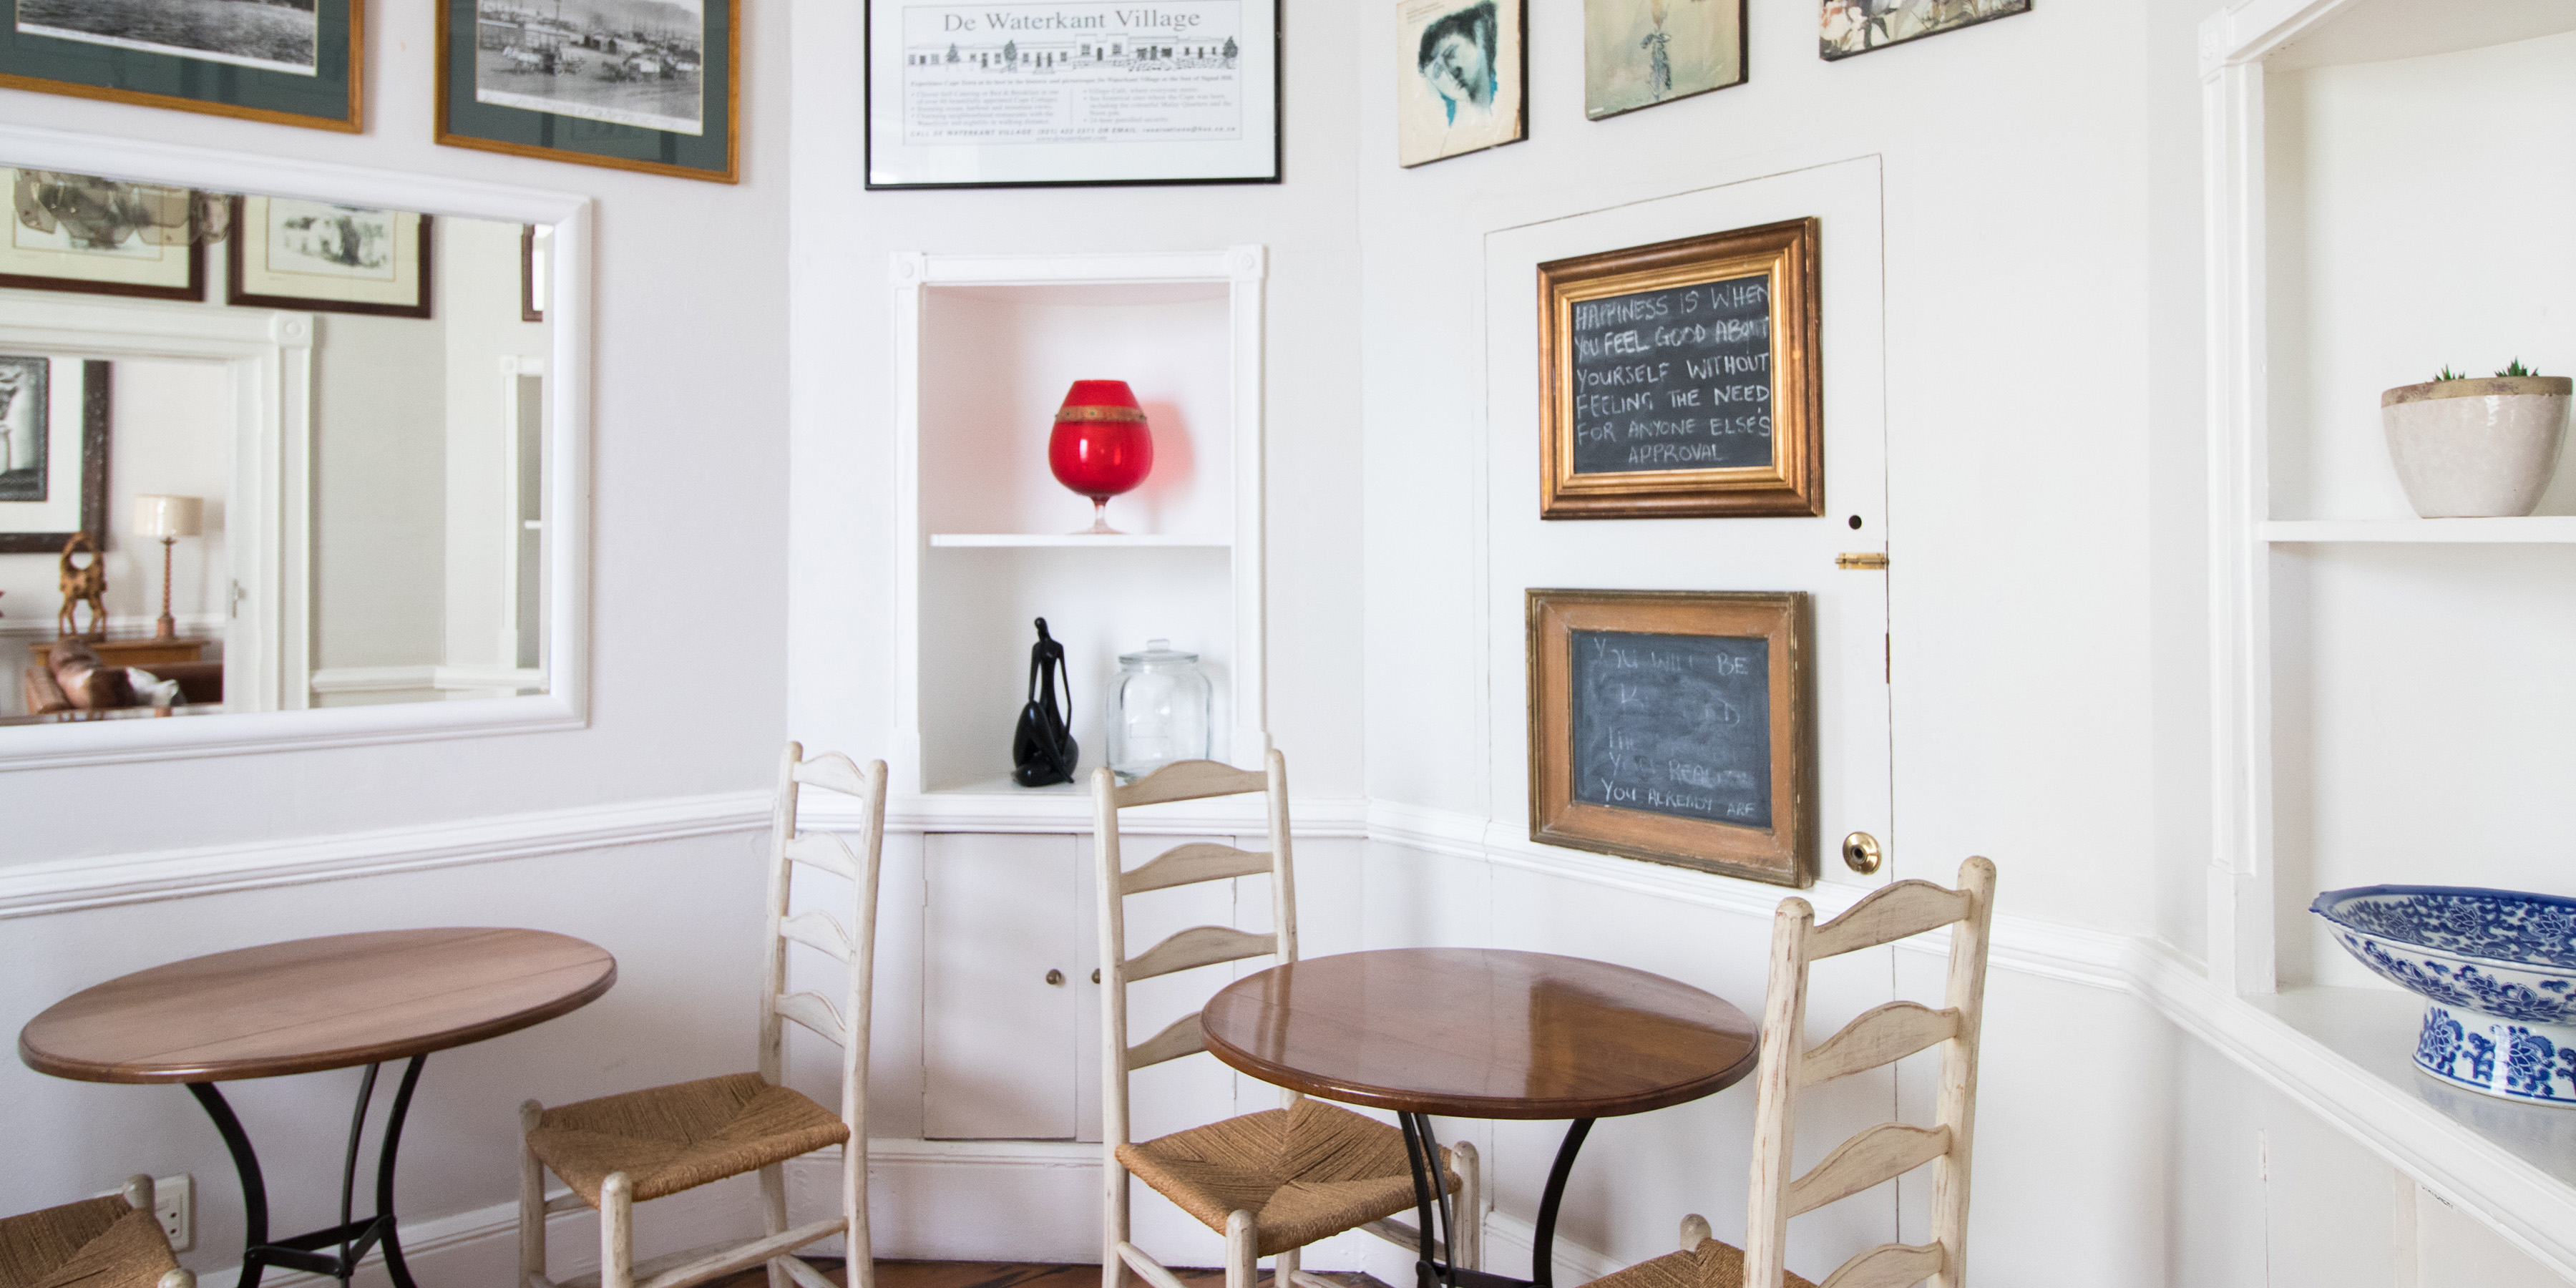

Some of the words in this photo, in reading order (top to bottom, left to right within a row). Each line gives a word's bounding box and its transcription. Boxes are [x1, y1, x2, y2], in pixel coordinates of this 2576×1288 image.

[944, 13, 977, 32] De
[985, 11, 1106, 30] Waterkant
[1115, 9, 1201, 31] Village
[1575, 296, 1669, 331] HAPPINESS
[1681, 290, 1699, 313] IS
[1711, 283, 1770, 310] WHEN
[1575, 334, 1599, 364] YOU
[1604, 329, 1649, 353] FEEL
[1655, 324, 1707, 347] GOOD
[1714, 316, 1770, 344] ABOUT
[1577, 361, 1669, 392] YOURSELF
[1687, 352, 1770, 380] WITHOUT
[1577, 392, 1654, 419] FEELING
[1669, 389, 1701, 408] THE
[1714, 385, 1770, 406] NEED
[1578, 421, 1617, 446] FOR
[1628, 419, 1696, 440] ANYONE
[1711, 408, 1771, 436] ELSE'S
[1629, 443, 1724, 464] APPROVAL
[1716, 652, 1750, 676] BE
[1725, 801, 1757, 817] ARE
